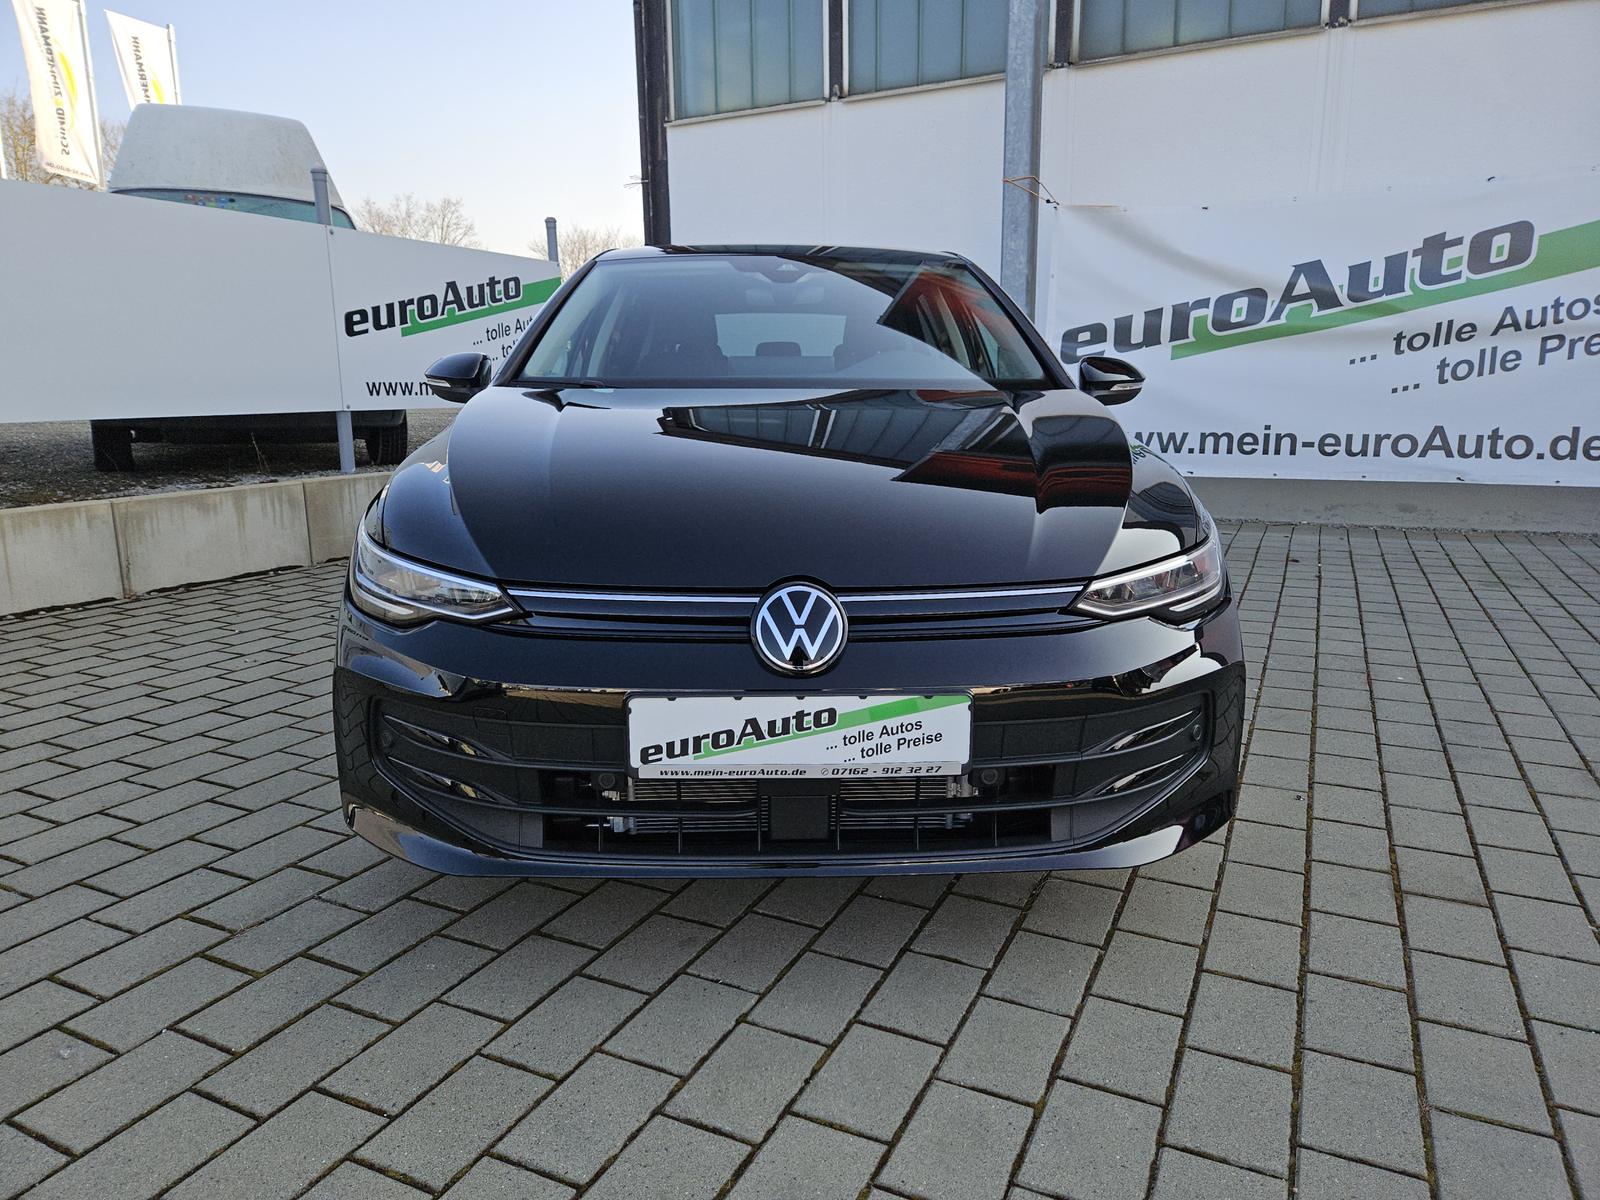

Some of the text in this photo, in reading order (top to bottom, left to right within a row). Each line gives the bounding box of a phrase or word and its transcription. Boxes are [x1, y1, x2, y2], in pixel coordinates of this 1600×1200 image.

[344, 276, 521, 337] euroAuto
[1060, 219, 1535, 365] euroAuto
[486, 322, 511, 341] tolle
[515, 316, 533, 334] Au
[1393, 319, 1478, 355] tolle
[1436, 346, 1522, 385] tolle
[1538, 333, 1600, 366] Pre
[758, 587, 841, 665] VW
[639, 707, 837, 765] euroAuto
[843, 730, 874, 746] tolle
[879, 720, 923, 739] Autos
[860, 743, 892, 759] tolle
[897, 732, 943, 750] Preise
[660, 768, 807, 776] www.mein-euroAuto.de
[831, 767, 869, 776] 07162
[881, 767, 902, 775] 912
[906, 766, 922, 774] 32
[925, 765, 942, 774] 27
